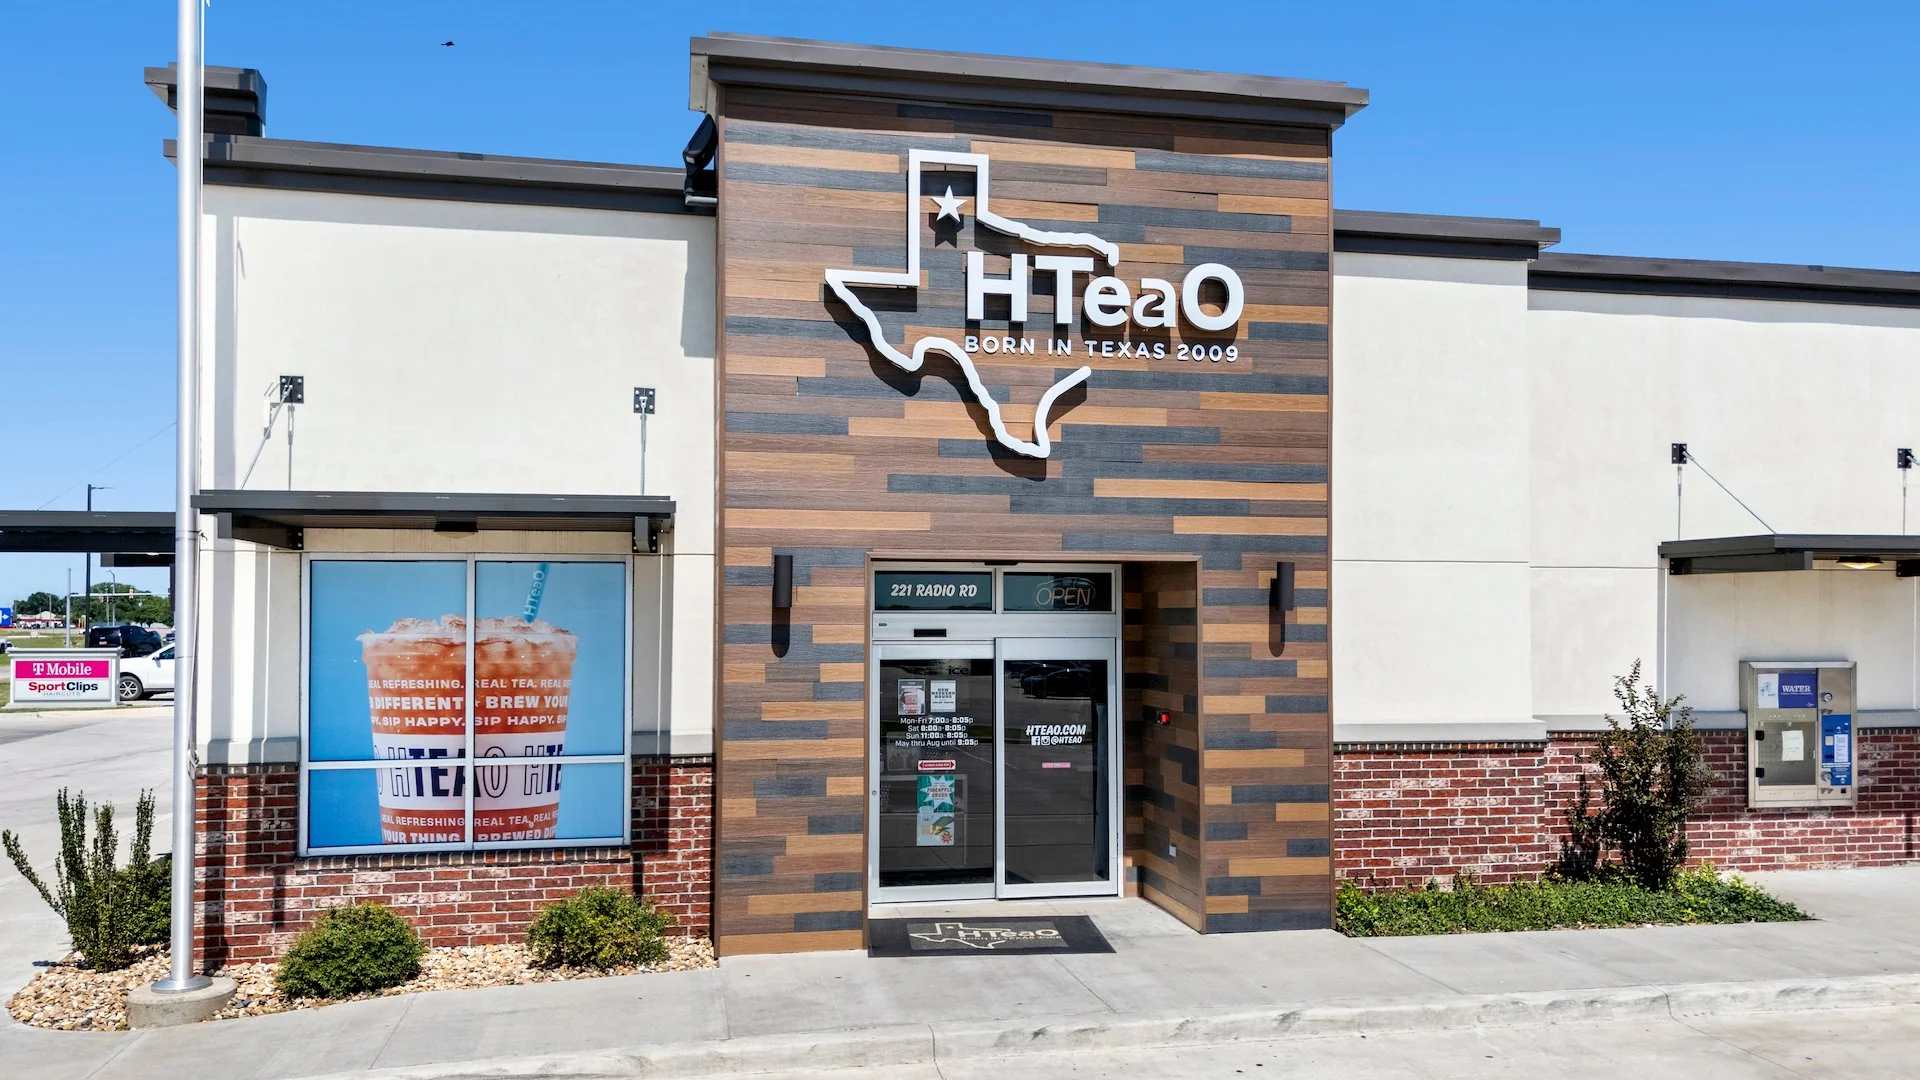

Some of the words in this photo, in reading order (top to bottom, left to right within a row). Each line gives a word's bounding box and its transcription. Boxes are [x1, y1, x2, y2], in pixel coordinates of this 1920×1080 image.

[966, 250, 1245, 332] HTeaO
[964, 335, 1035, 355] BORN
[1047, 338, 1072, 356] IN
[1084, 340, 1166, 360] TEXAS
[1176, 343, 1239, 362] 2009
[523, 570, 545, 616] HTeaO
[890, 584, 912, 597] 221
[915, 584, 956, 597] RADIO
[959, 584, 978, 598] RD
[1036, 587, 1092, 606] OPEN
[46, 663, 92, 675] Mobile
[948, 665, 969, 675] ice
[382, 680, 464, 689] REFRESHING.
[475, 679, 507, 688] REAL
[511, 679, 537, 688] TEA.
[540, 679, 562, 688] REAL
[1782, 685, 1811, 693] WATER
[375, 696, 464, 710] DIFFERENT
[485, 696, 540, 709] BREW
[382, 716, 401, 726] SIP
[404, 717, 465, 727] HAPPY.
[475, 717, 501, 726] SIP
[507, 716, 554, 726] HAPPY.
[1025, 724, 1087, 736] HTEAO.COM
[926, 740, 940, 748] Aug
[1051, 736, 1083, 745] @HTEAO
[388, 746, 508, 798] HTEAO
[474, 817, 505, 827] REAL
[508, 815, 531, 825] TEA.
[533, 812, 551, 822] REAL
[958, 929, 1060, 938] HTeaO
